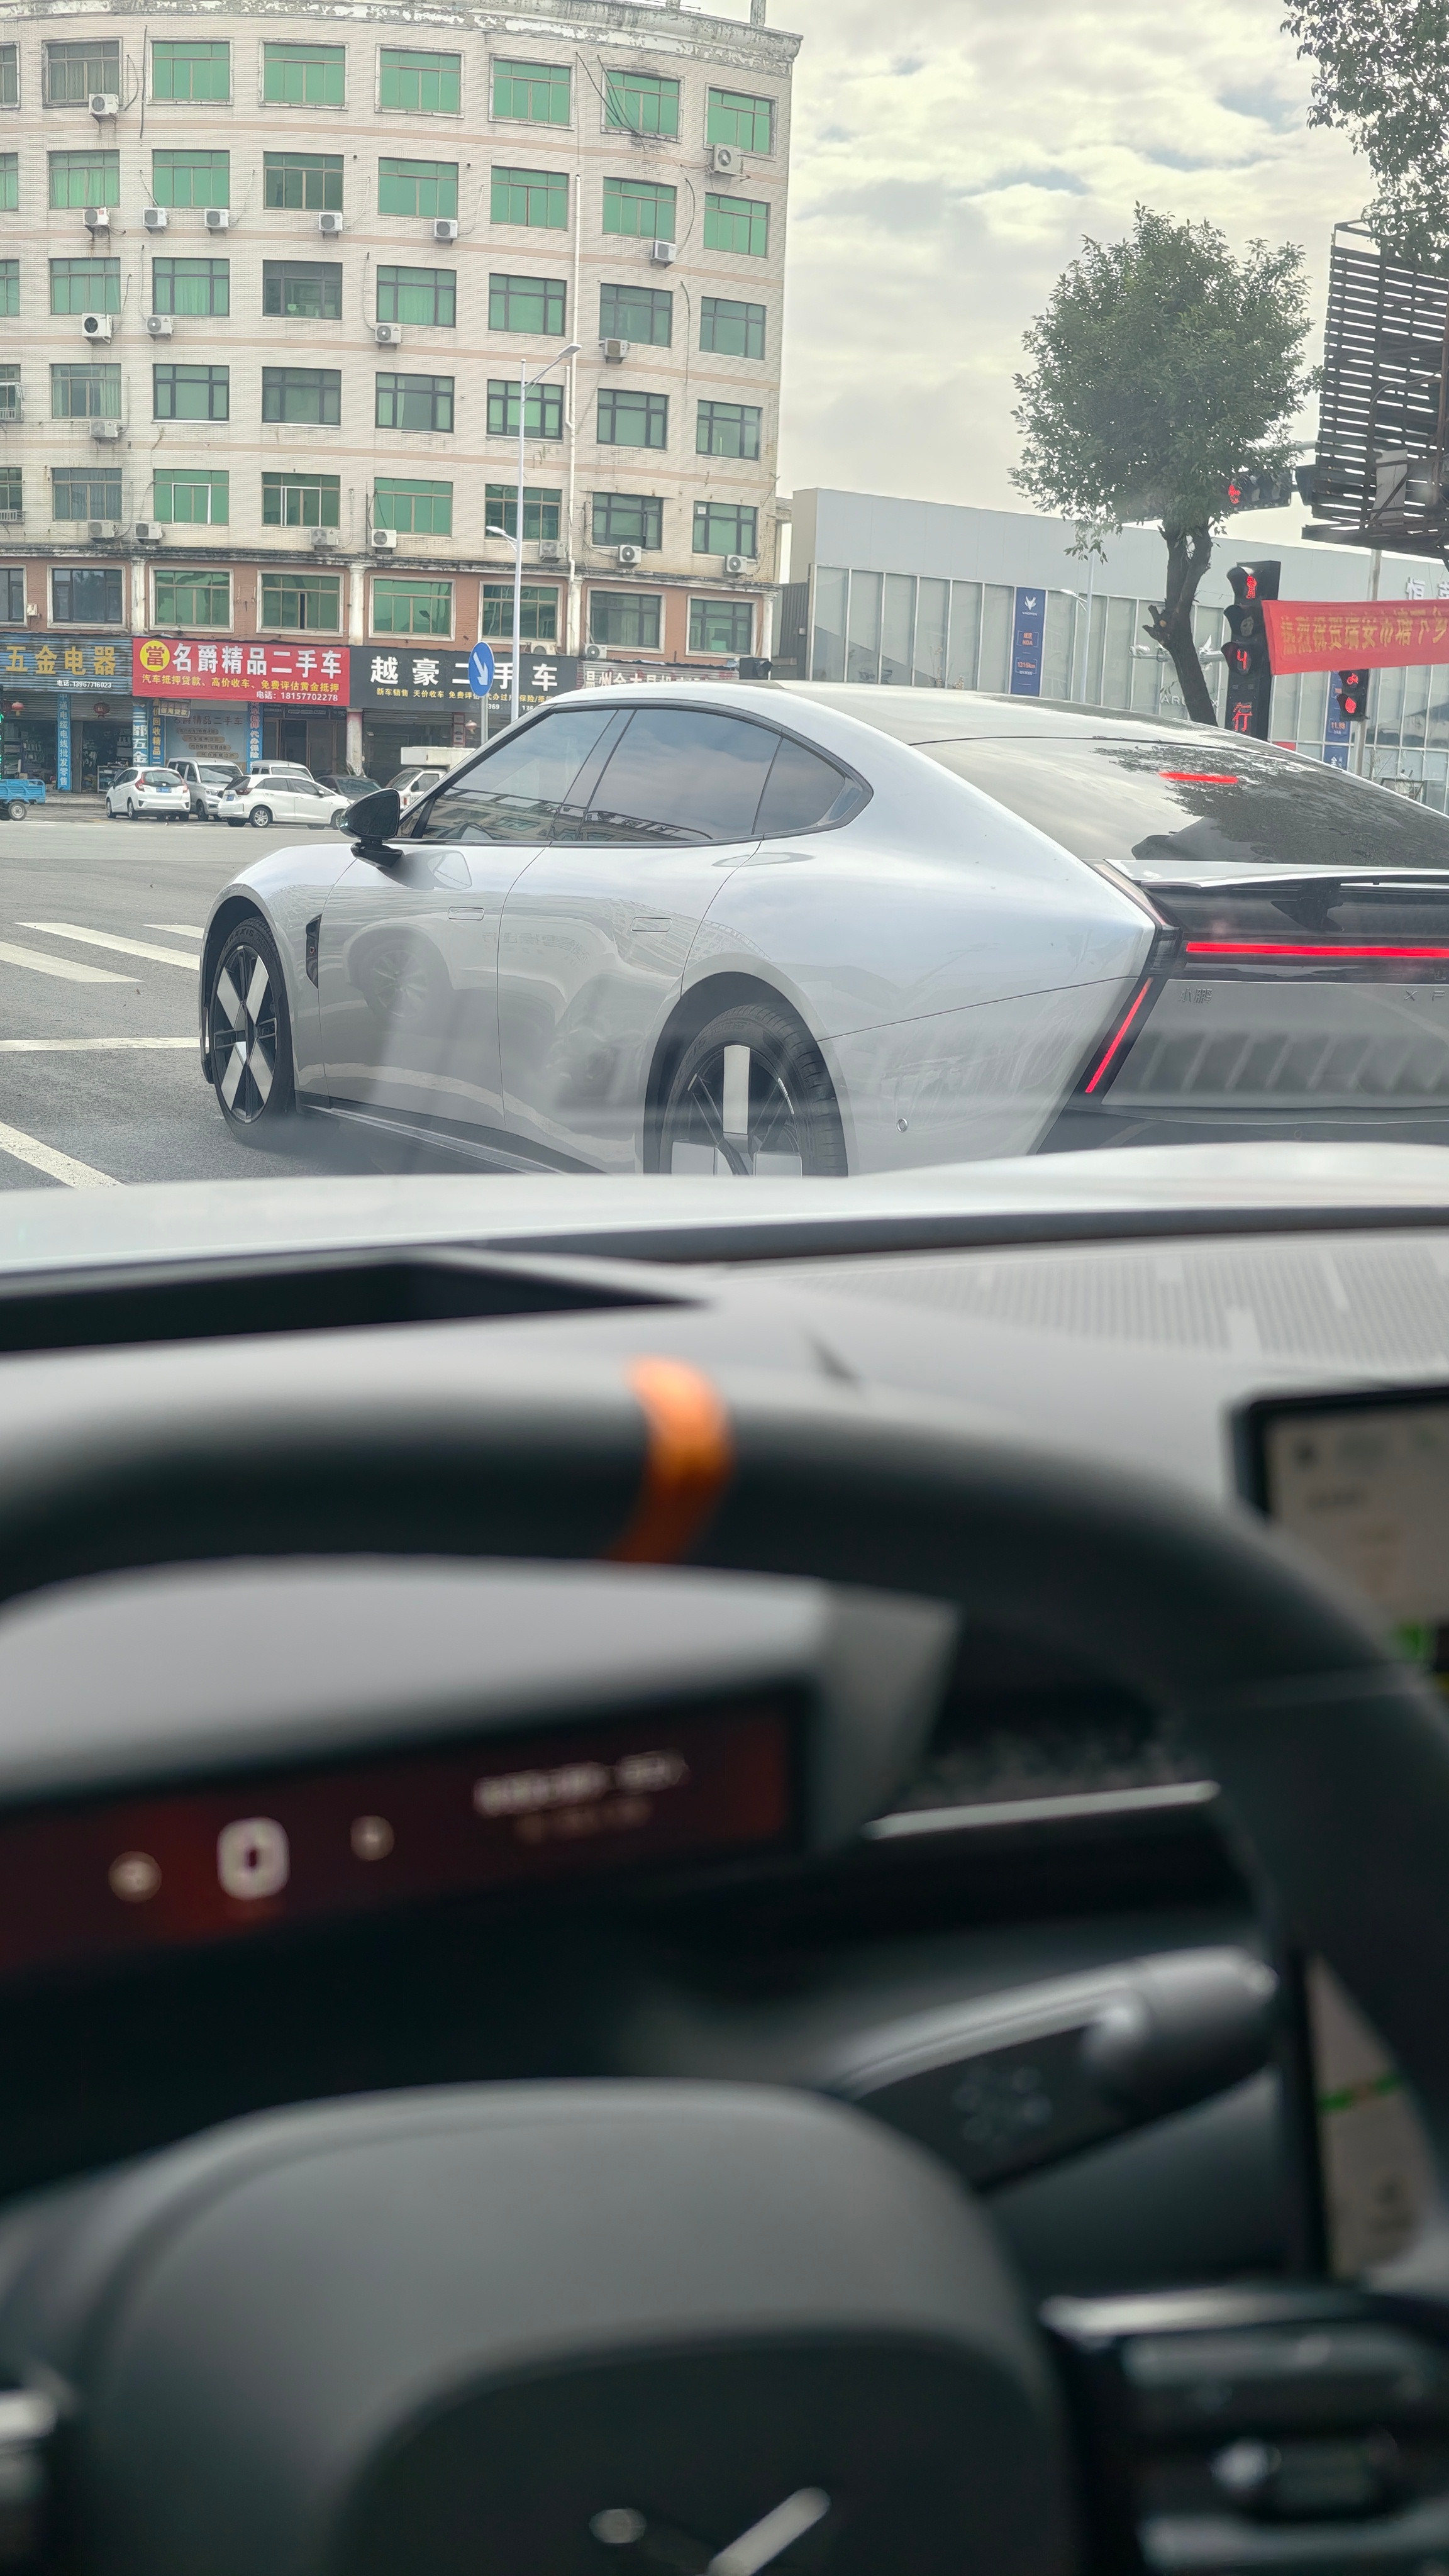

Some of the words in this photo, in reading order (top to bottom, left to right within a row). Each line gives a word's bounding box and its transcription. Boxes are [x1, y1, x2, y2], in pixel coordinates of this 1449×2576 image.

[4, 645, 116, 675] 五金电器
[172, 643, 341, 679] 名爵精品二手车
[370, 656, 558, 691] 越豪二手车
[376, 687, 409, 697] 新车销售
[1232, 702, 1253, 732] 行
[133, 711, 148, 767] 三都五金
